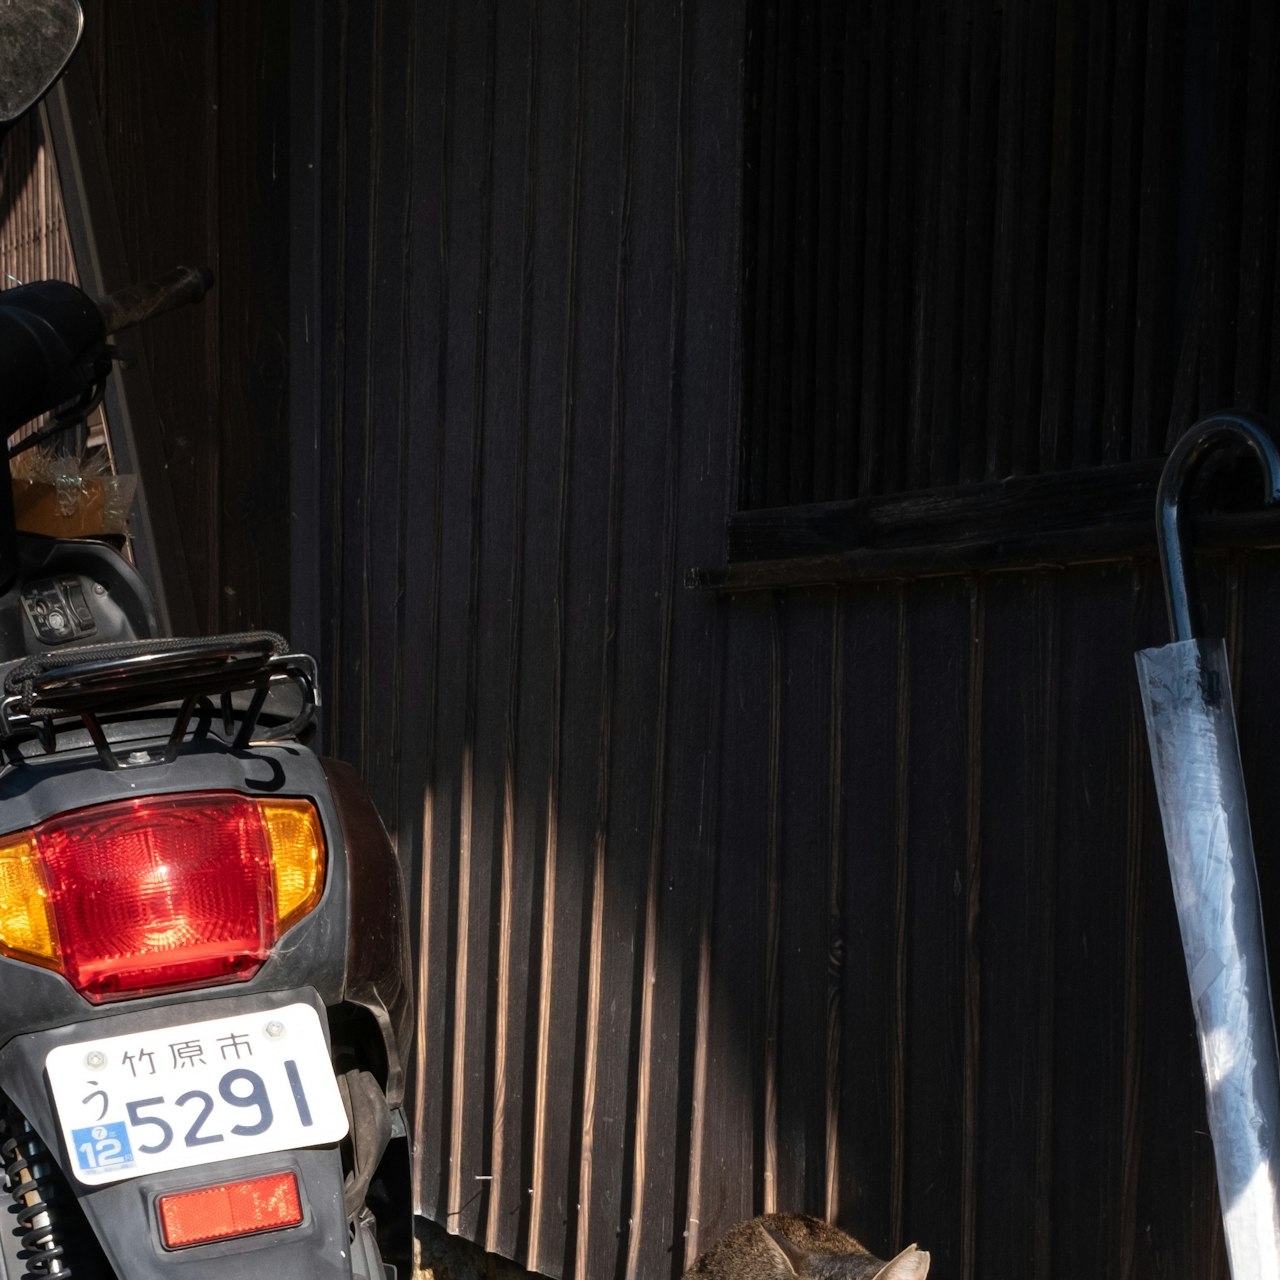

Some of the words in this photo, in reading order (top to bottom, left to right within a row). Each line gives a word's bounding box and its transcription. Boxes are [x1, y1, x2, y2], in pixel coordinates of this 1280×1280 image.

[122, 1033, 254, 1077] 竹原市
[82, 1081, 109, 1121] う
[125, 1060, 314, 1154] 5291
